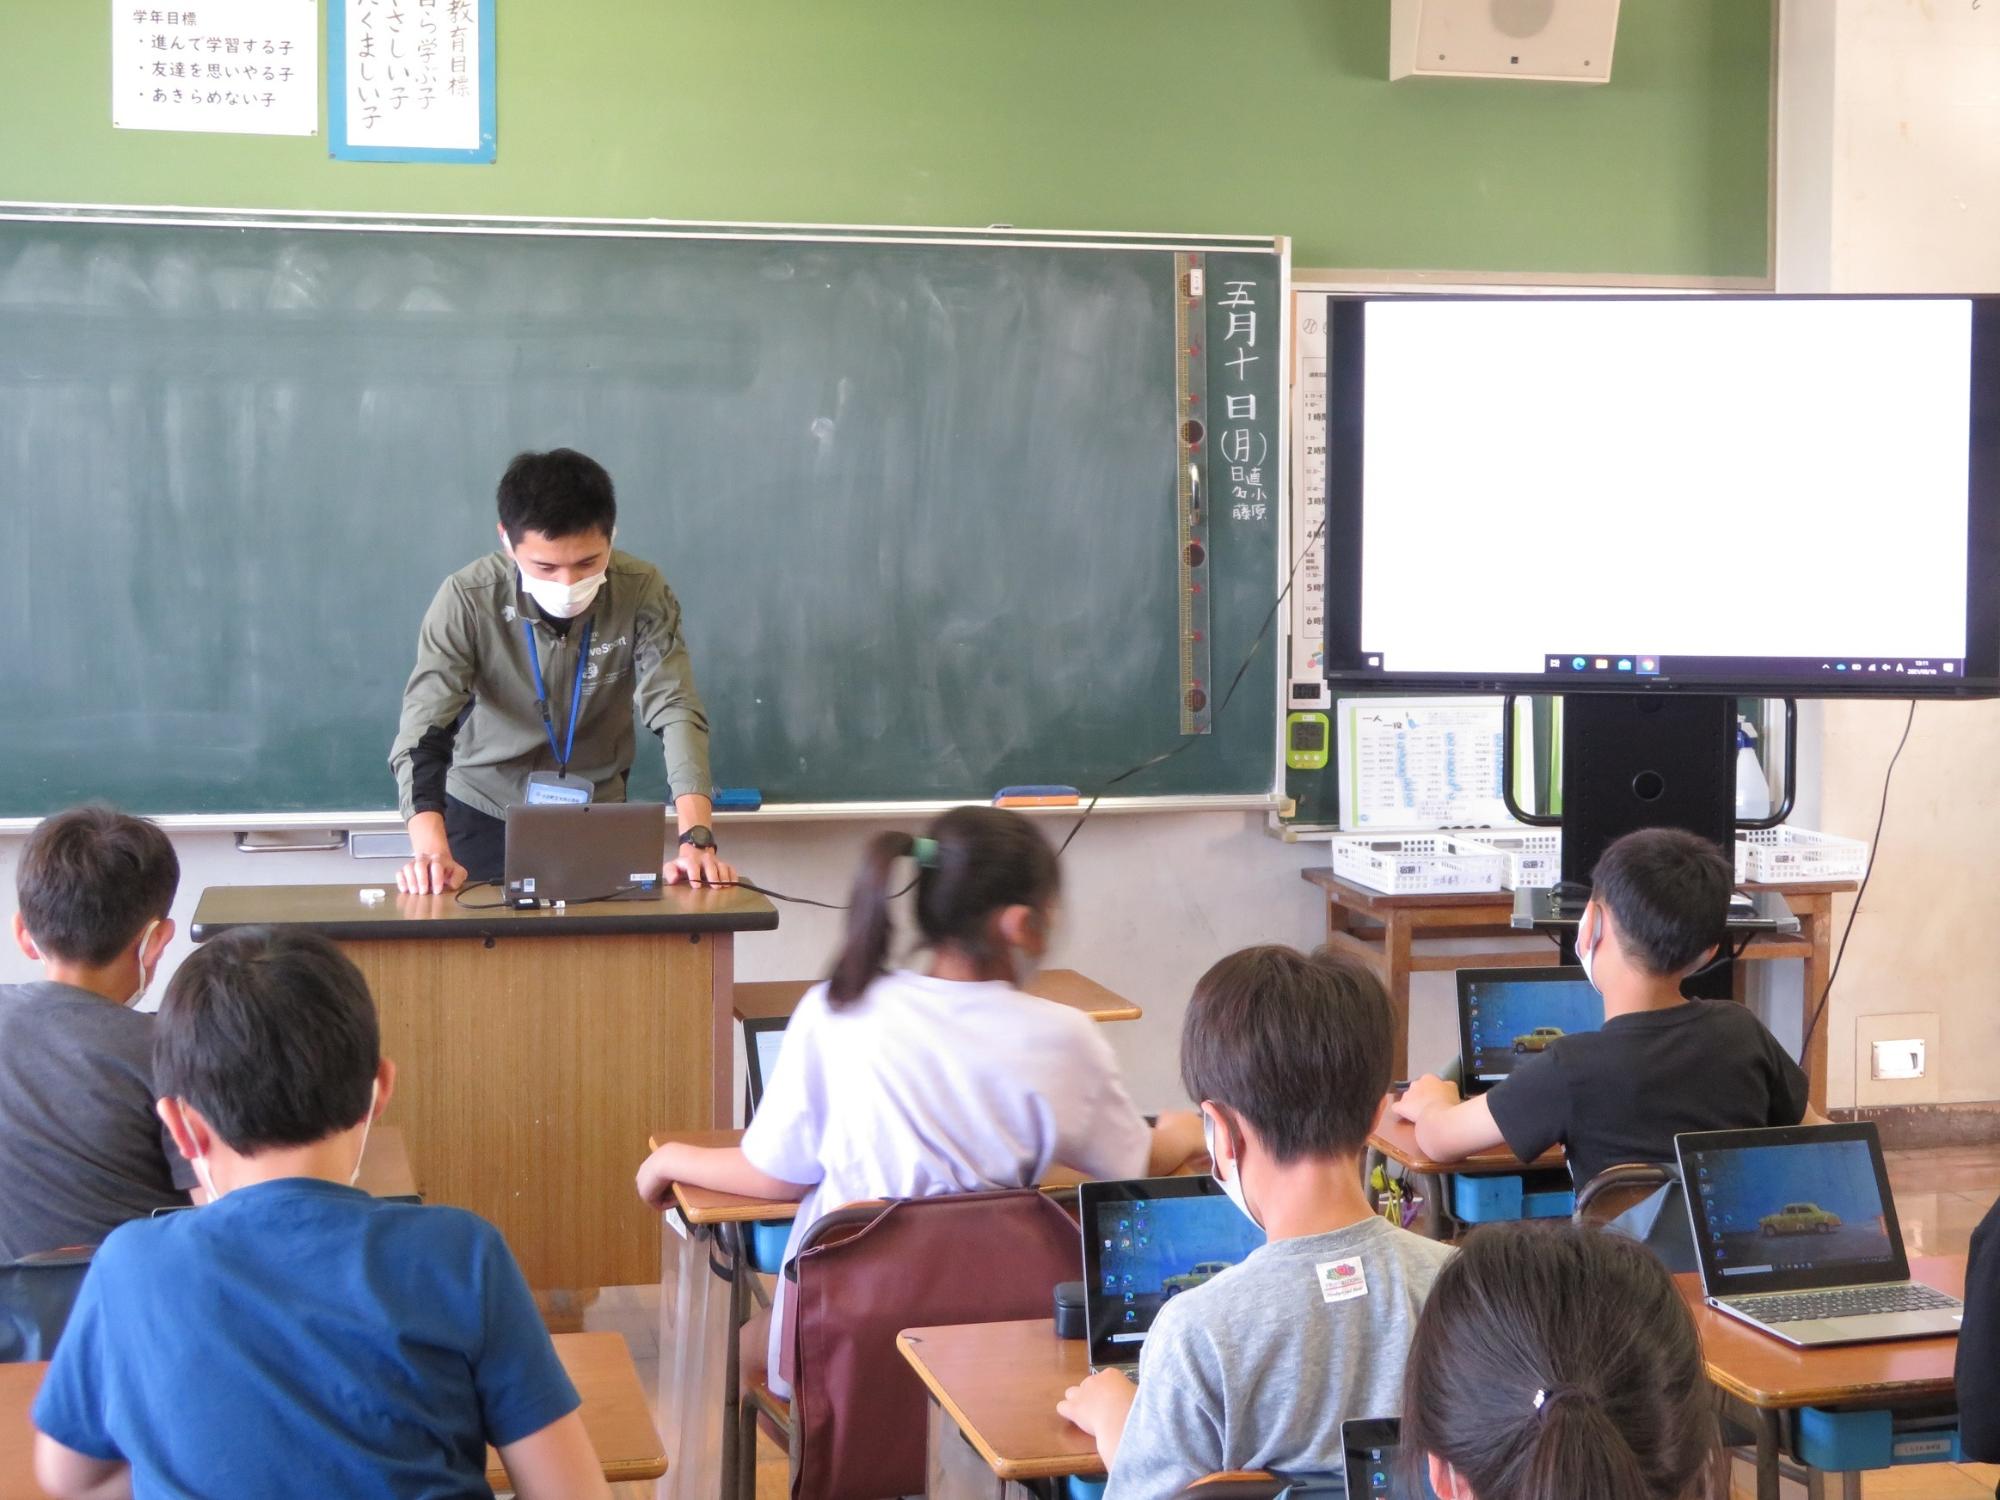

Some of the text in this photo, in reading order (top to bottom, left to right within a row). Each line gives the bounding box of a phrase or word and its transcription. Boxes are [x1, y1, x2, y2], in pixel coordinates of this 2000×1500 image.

[133, 10, 197, 26] 学年目標
[358, 0, 382, 129] くましい子
[386, 0, 409, 109] さしい子
